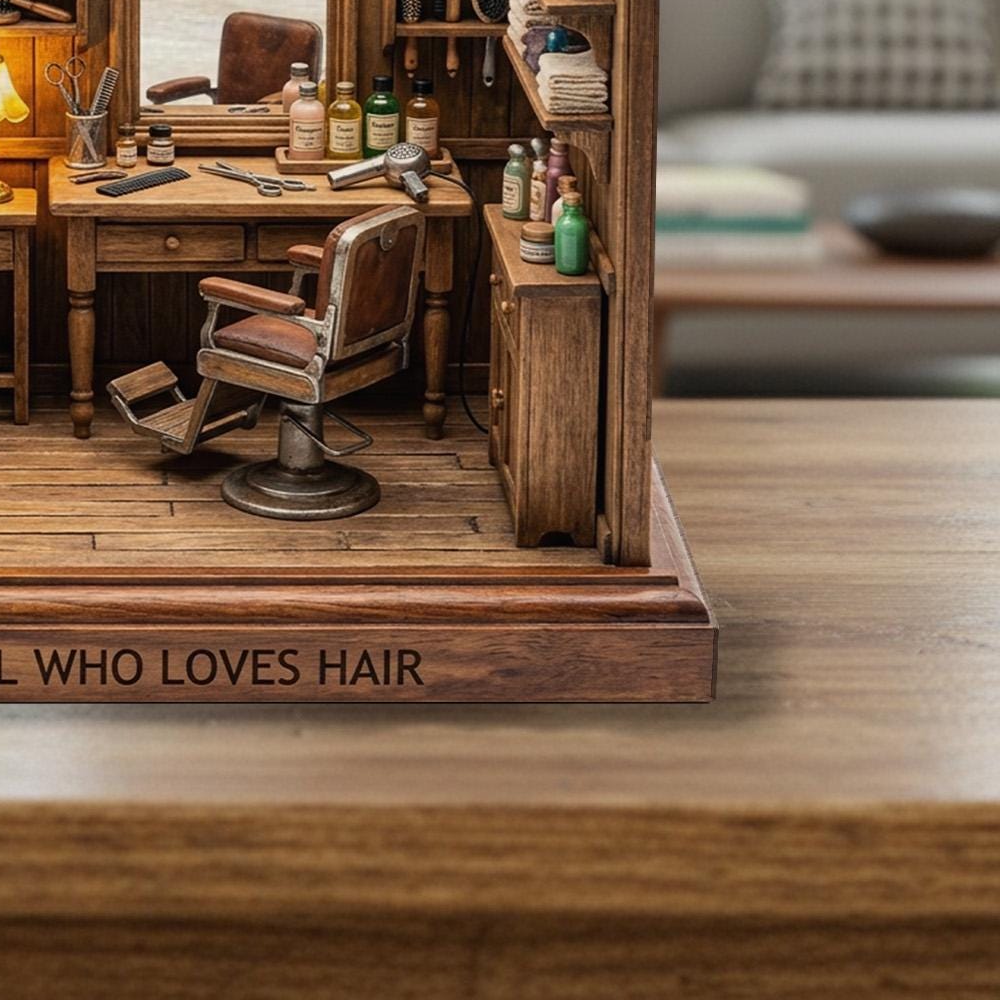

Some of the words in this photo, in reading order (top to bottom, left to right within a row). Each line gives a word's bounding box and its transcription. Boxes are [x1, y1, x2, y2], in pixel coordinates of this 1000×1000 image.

[34, 648, 144, 686] WHO
[162, 648, 301, 686] LOVES
[318, 649, 424, 686] HAIR
